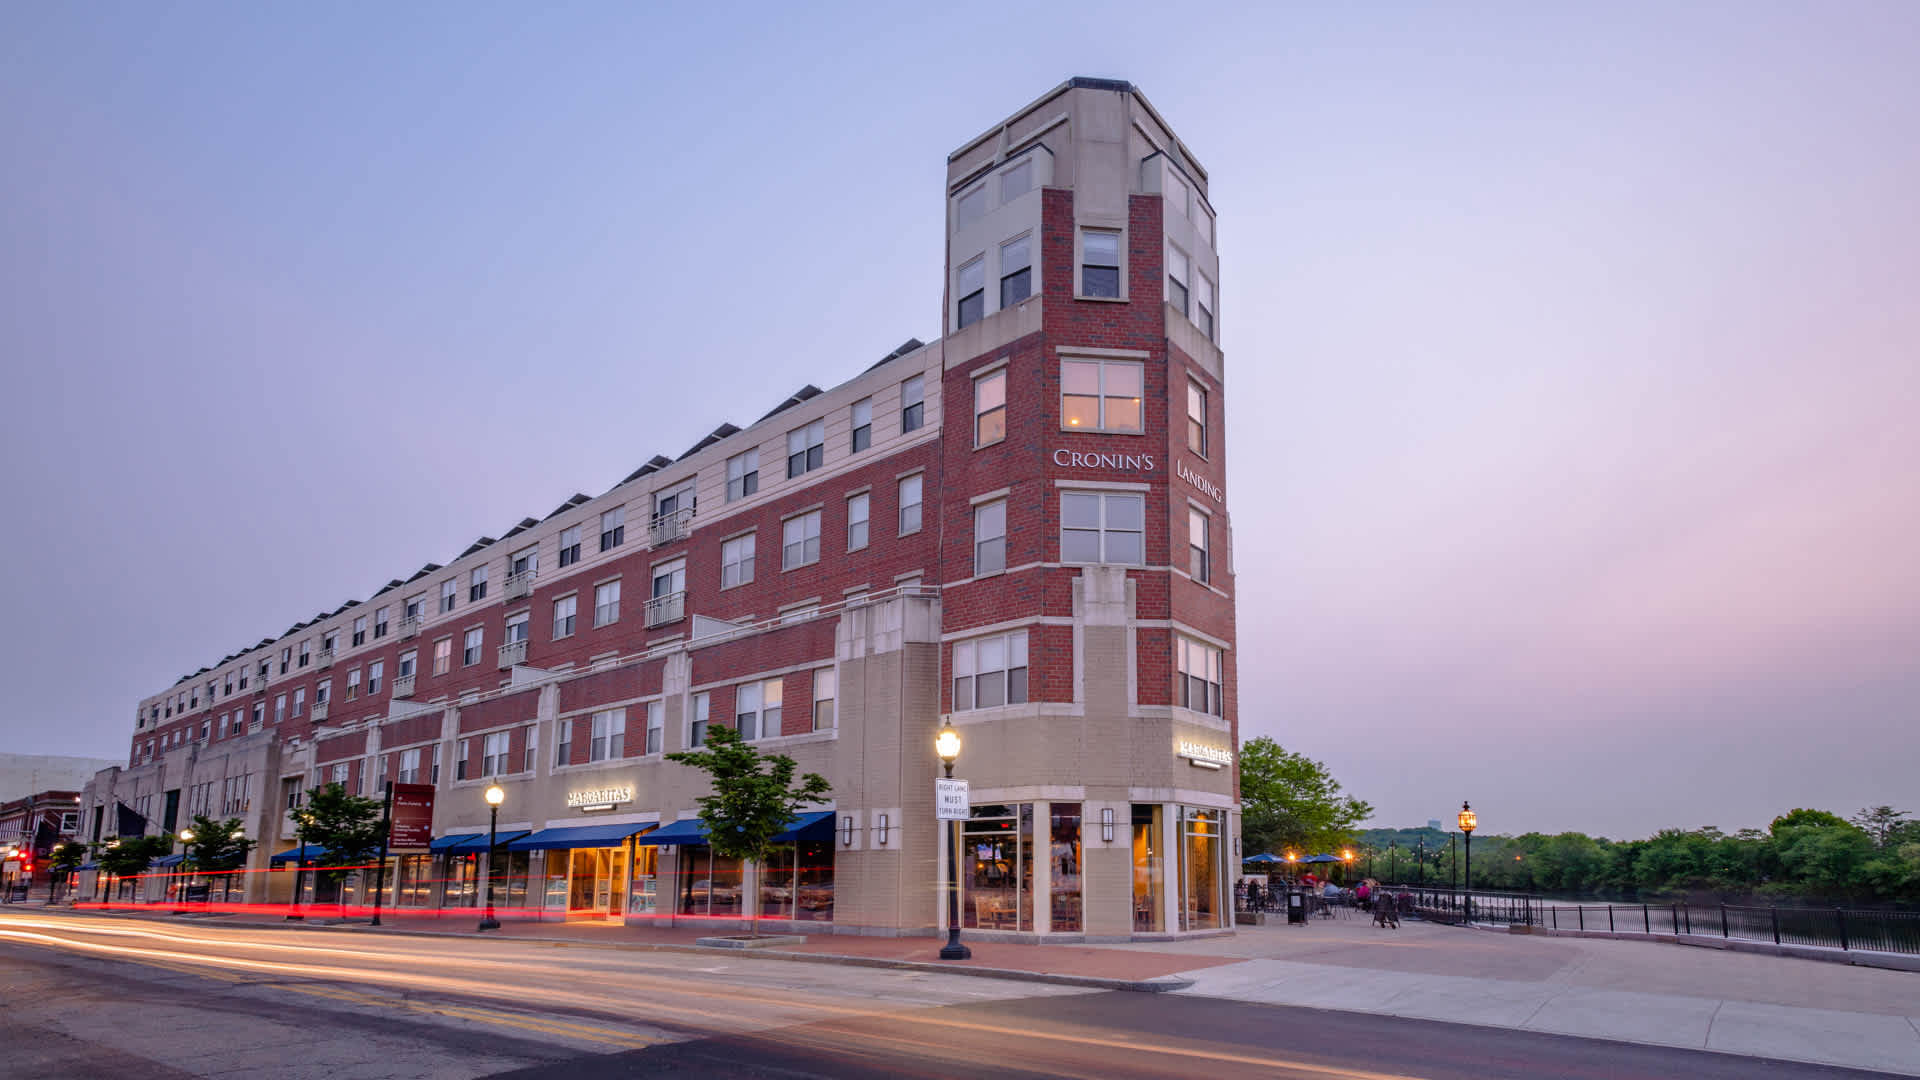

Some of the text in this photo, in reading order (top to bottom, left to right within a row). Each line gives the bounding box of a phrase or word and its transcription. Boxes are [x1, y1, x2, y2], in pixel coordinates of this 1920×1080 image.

[1053, 449, 1222, 503] CRONIN'S LANDING
[939, 783, 953, 791] RIGHT
[567, 787, 632, 806] MARGARITAS
[944, 794, 962, 804] MUST
[939, 807, 969, 818] TURN RIGHT
